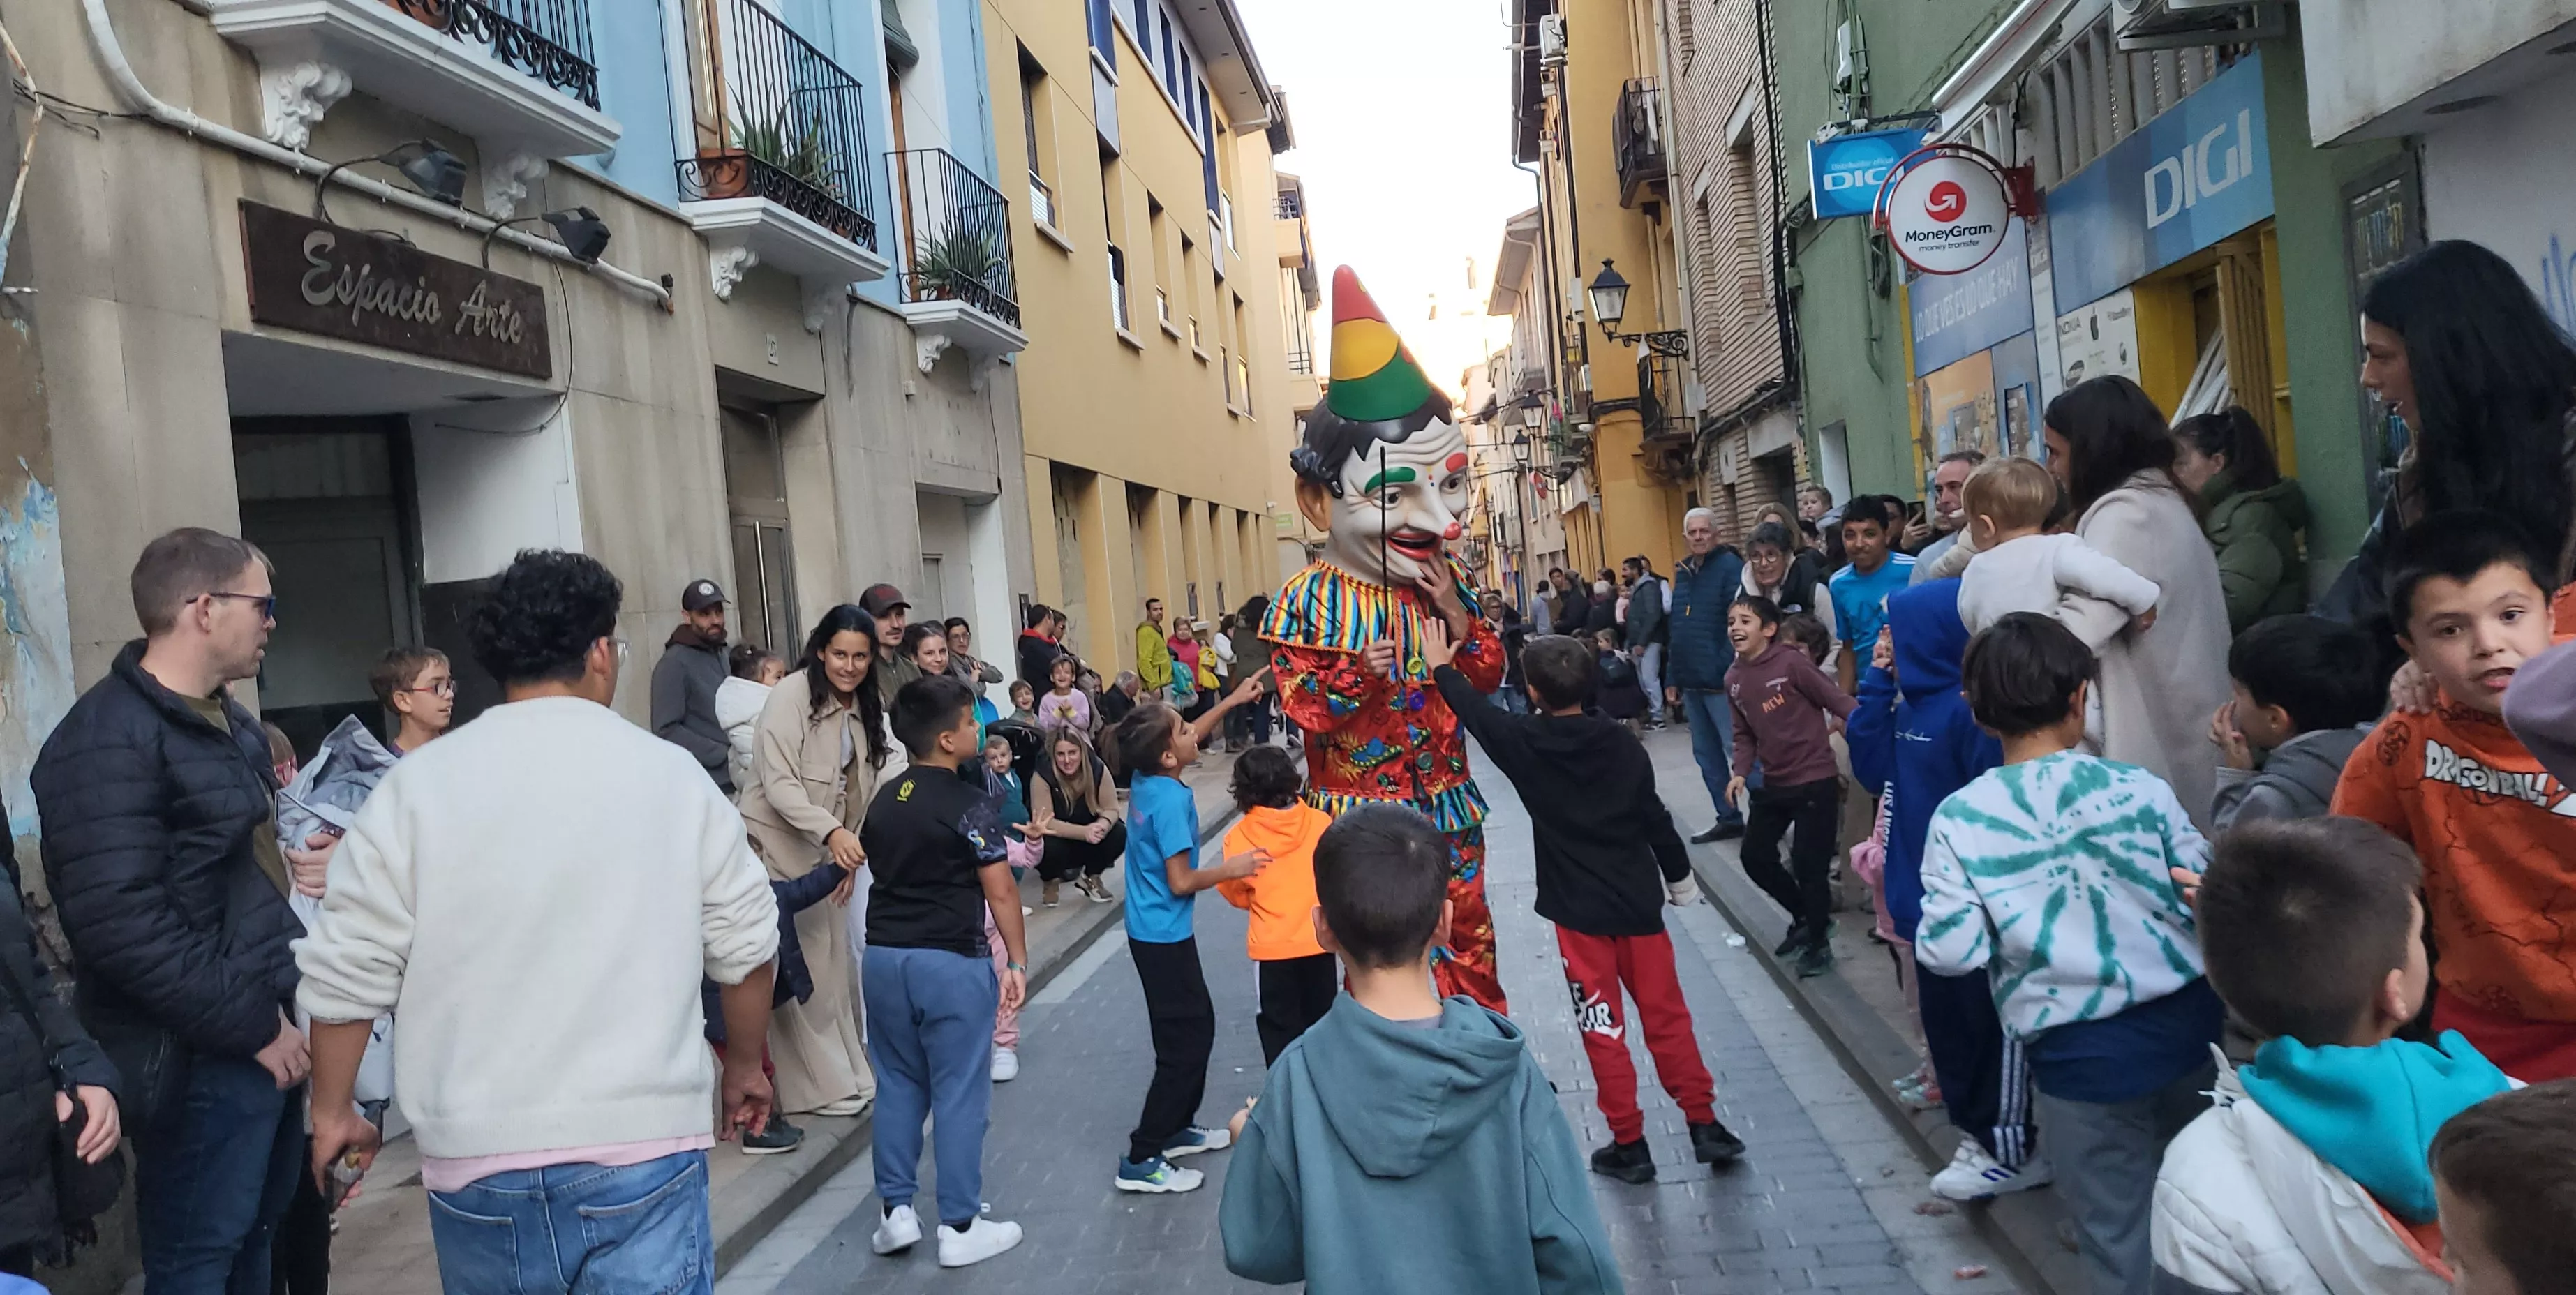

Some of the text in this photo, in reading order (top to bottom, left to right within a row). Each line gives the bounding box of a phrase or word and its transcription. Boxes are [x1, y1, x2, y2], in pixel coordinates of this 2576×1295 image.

[2145, 107, 2253, 230] DIGI
[1905, 223, 1993, 243] MoneyGram
[1919, 239, 1981, 252] money transfer
[301, 230, 523, 344] Espacio Arte
